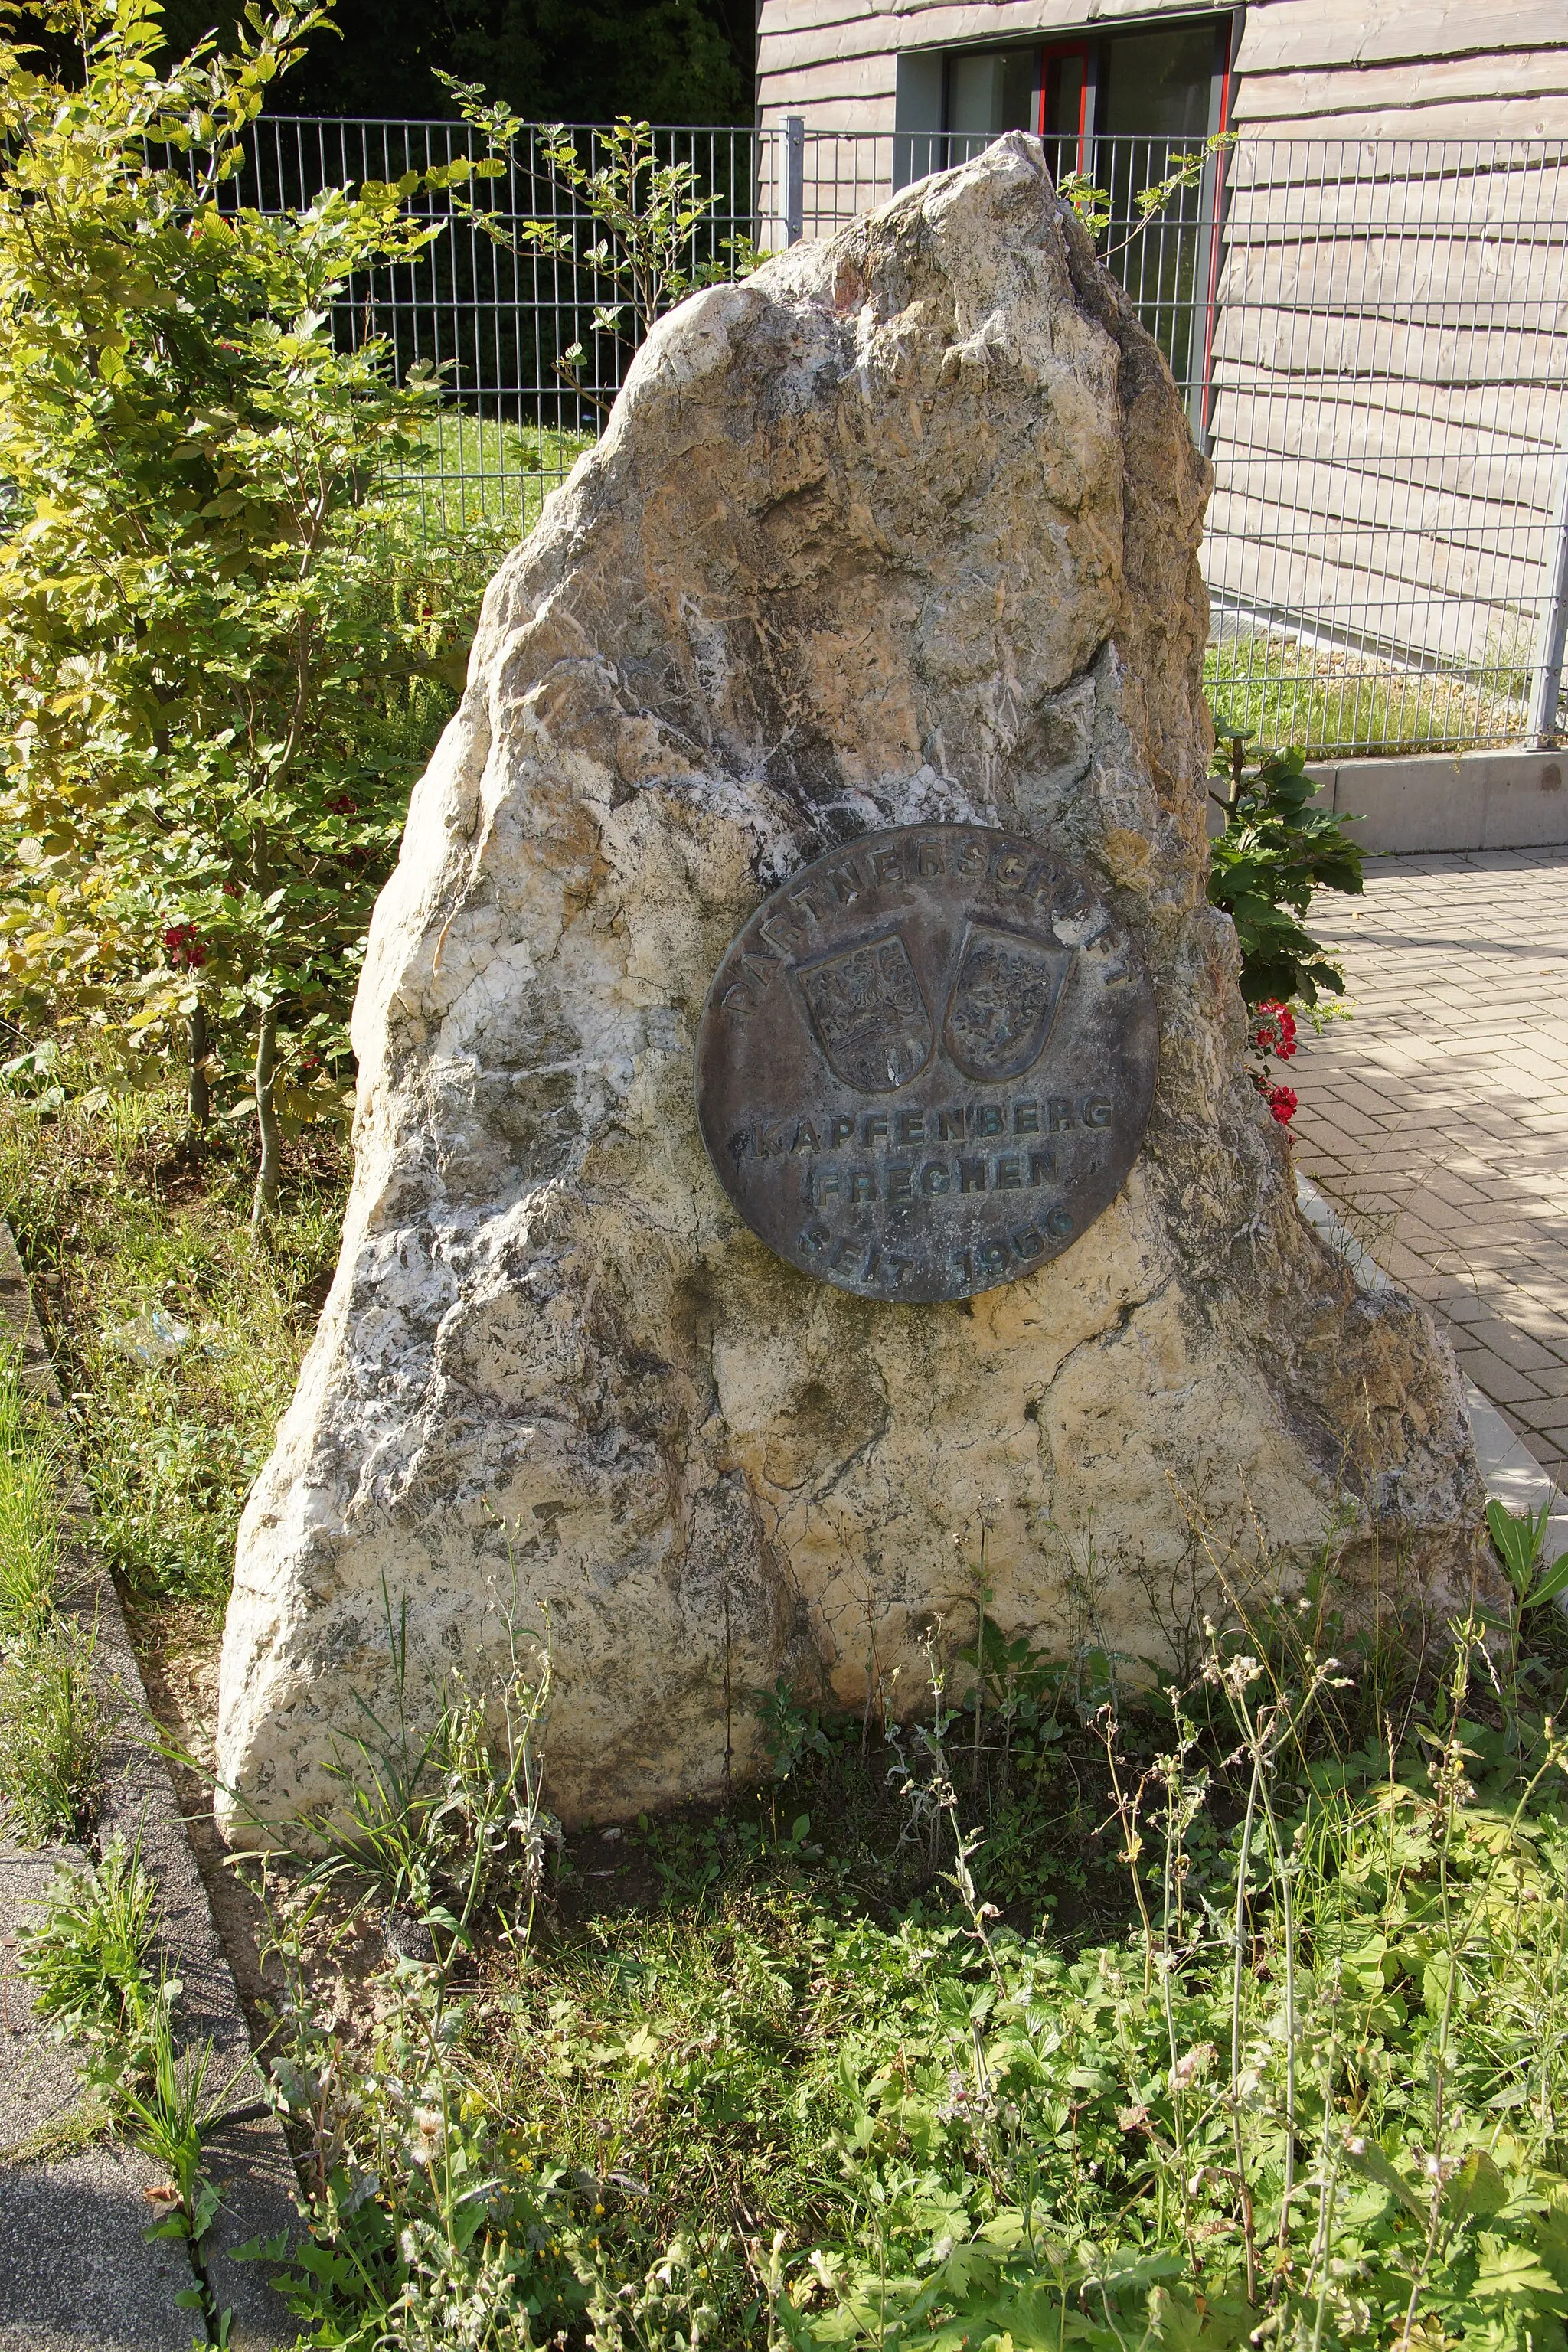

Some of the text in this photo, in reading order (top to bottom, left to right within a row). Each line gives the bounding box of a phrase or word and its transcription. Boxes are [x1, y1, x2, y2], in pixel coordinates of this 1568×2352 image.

[752, 1096, 1115, 1158] KAPFENBERG
[815, 1153, 1060, 1206] FRECHEN
[800, 1205, 1076, 1289] SEIT 1956
